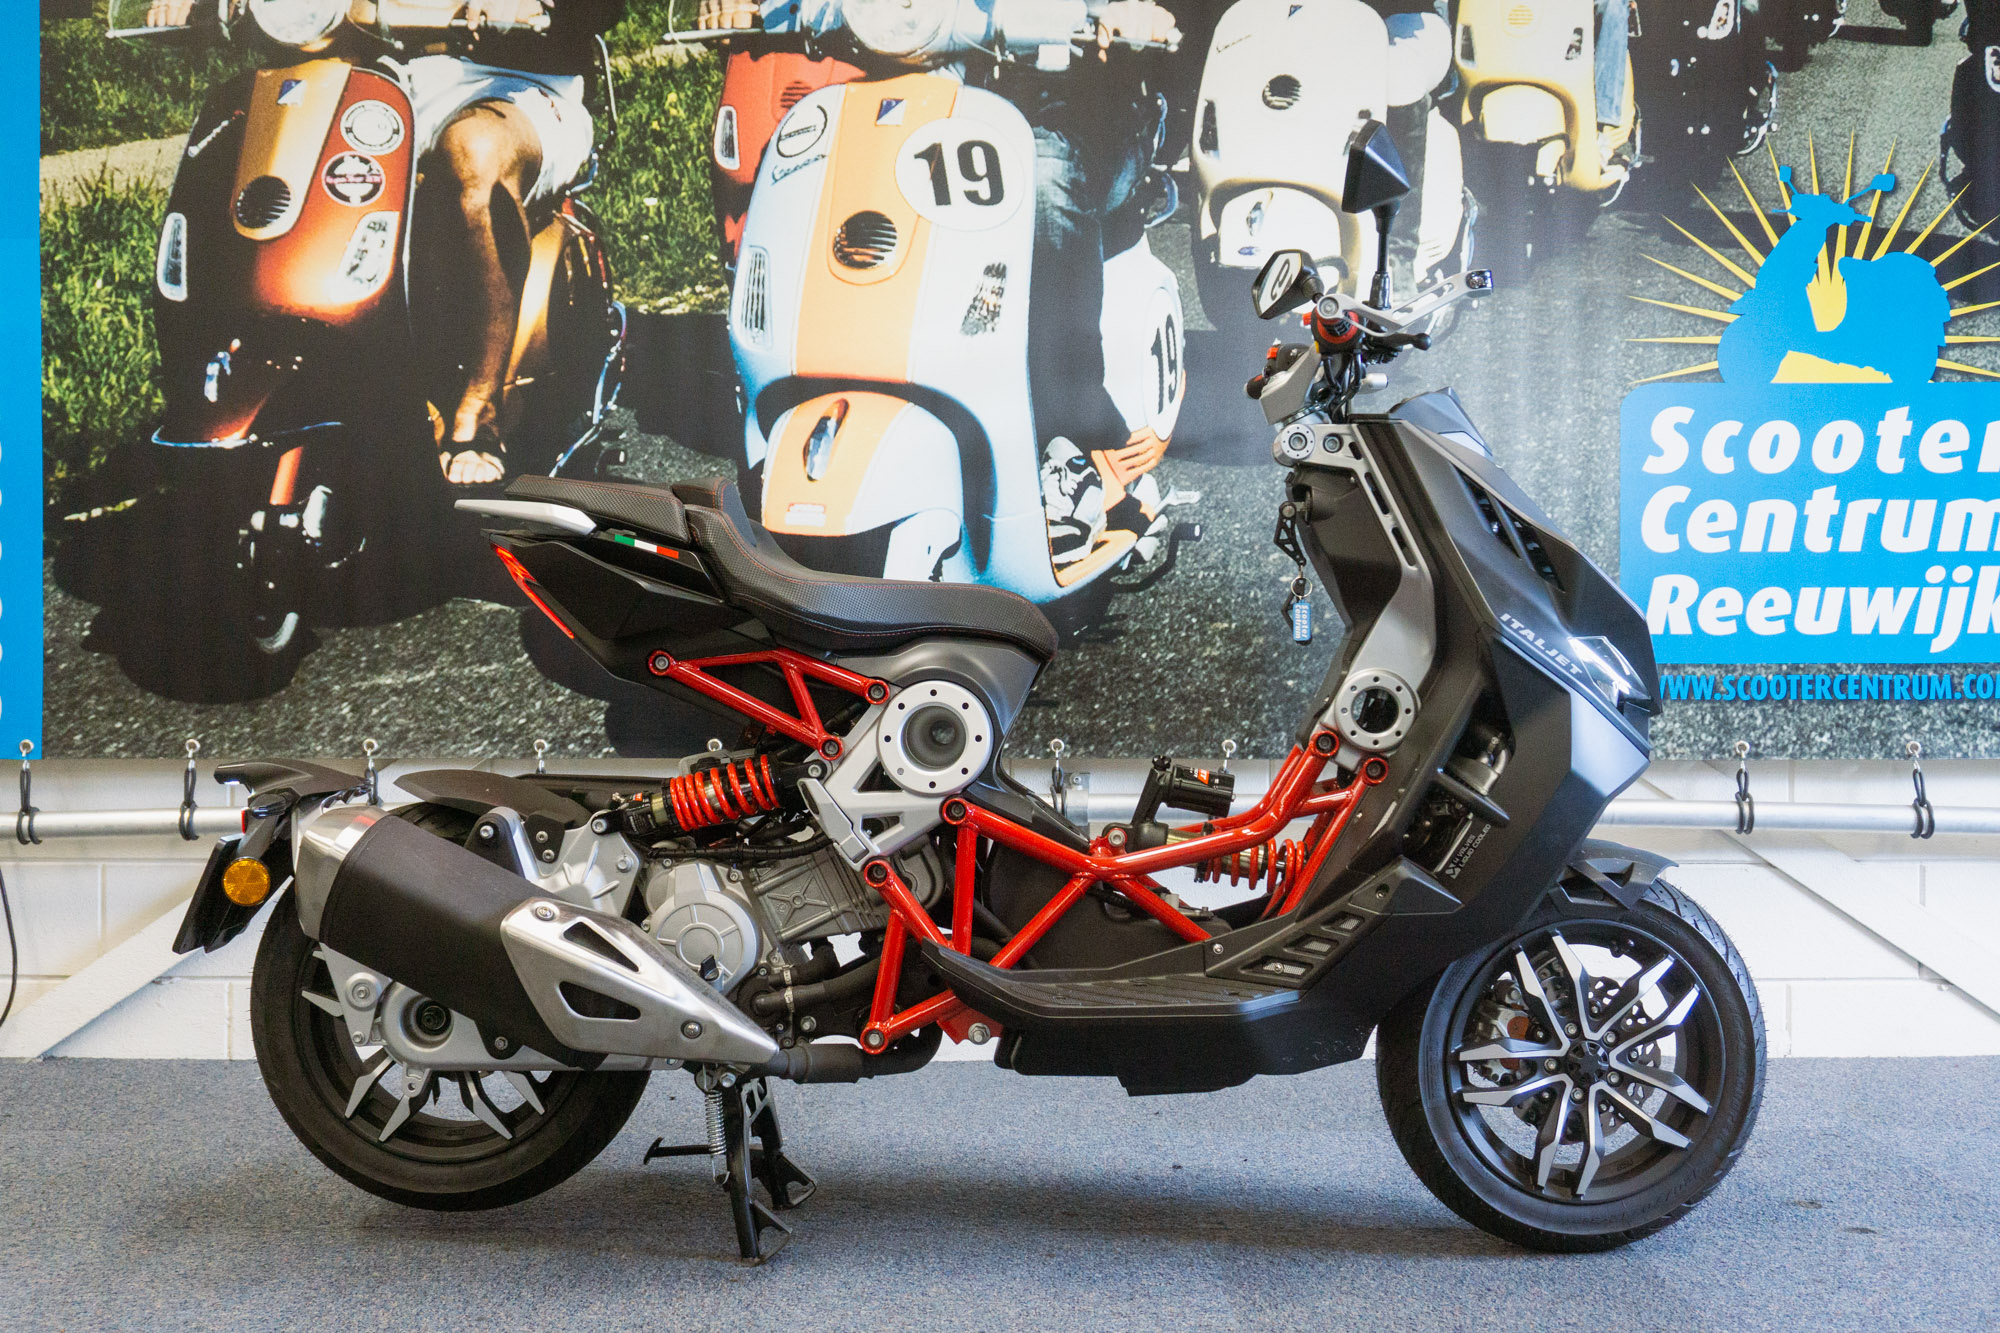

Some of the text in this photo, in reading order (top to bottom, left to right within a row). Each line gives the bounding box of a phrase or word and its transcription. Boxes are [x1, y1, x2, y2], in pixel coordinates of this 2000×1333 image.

[913, 139, 1004, 206] 19
[1150, 313, 1177, 415] 19
[1640, 485, 2000, 554] Centrum
[1500, 613, 1583, 675] ITALJET
[1659, 673, 2000, 701] WW.SCOOTERCENTRUM.CO
[1457, 834, 1475, 857] VALVES
[1459, 823, 1491, 867] LIQUID COOLED
